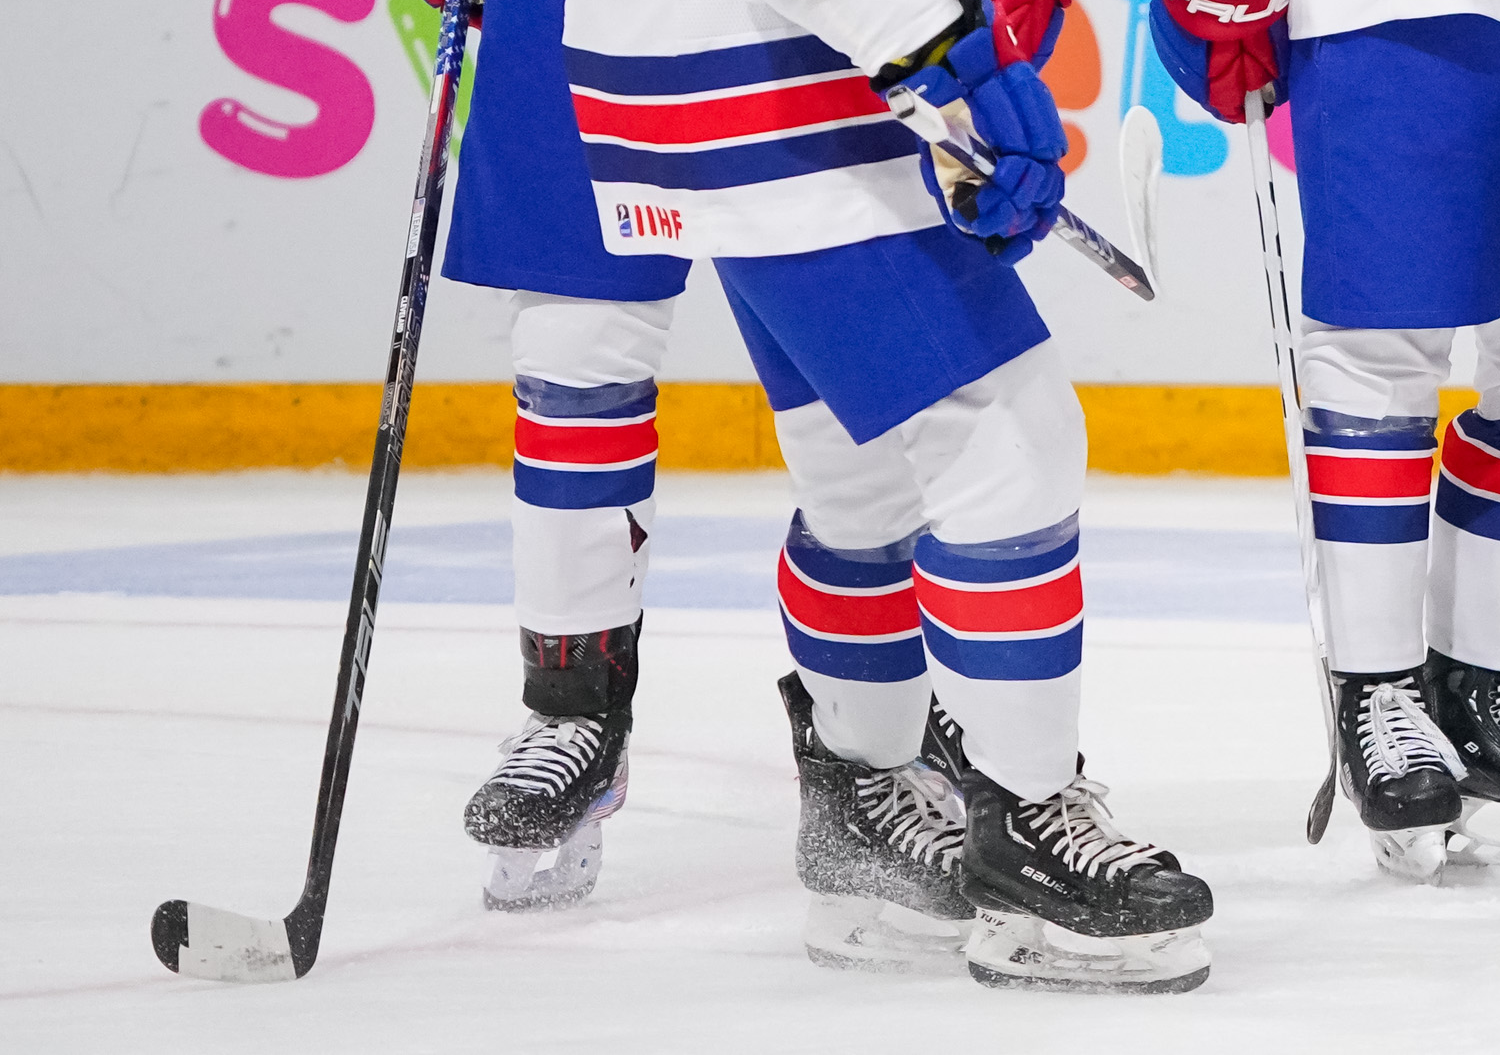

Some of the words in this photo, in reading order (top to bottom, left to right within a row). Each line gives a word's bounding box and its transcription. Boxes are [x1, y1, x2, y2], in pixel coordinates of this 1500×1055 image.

[410, 213, 422, 238] TEAM
[634, 204, 683, 241] IIHF
[408, 237, 418, 257] USA
[396, 295, 409, 333] CLEVELAND
[926, 752, 948, 769] PRO
[1020, 864, 1069, 895] BAUE
